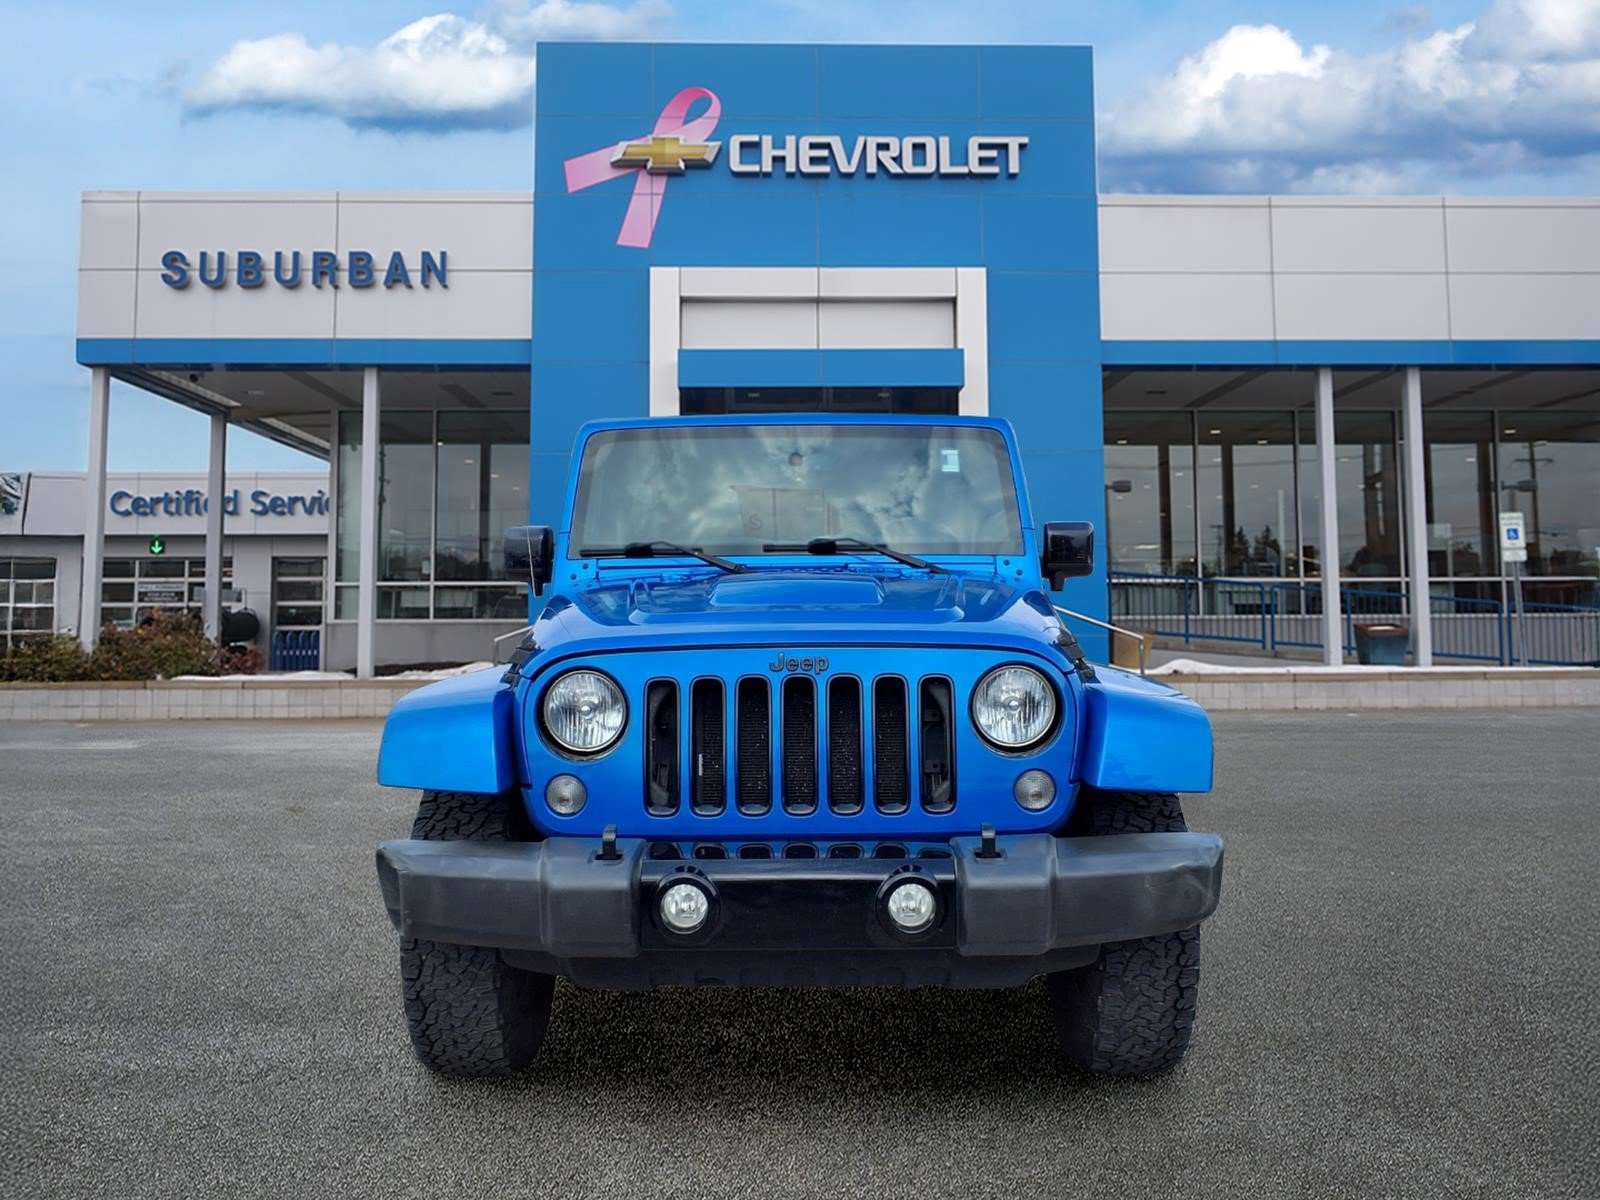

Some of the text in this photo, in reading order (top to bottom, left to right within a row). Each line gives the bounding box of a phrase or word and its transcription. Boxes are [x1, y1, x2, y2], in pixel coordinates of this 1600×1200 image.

[729, 134, 1029, 175] CHEVROLET
[161, 250, 448, 289] SUBURBAN
[110, 490, 330, 517] Certifid Servi
[769, 652, 829, 675] Jeep
